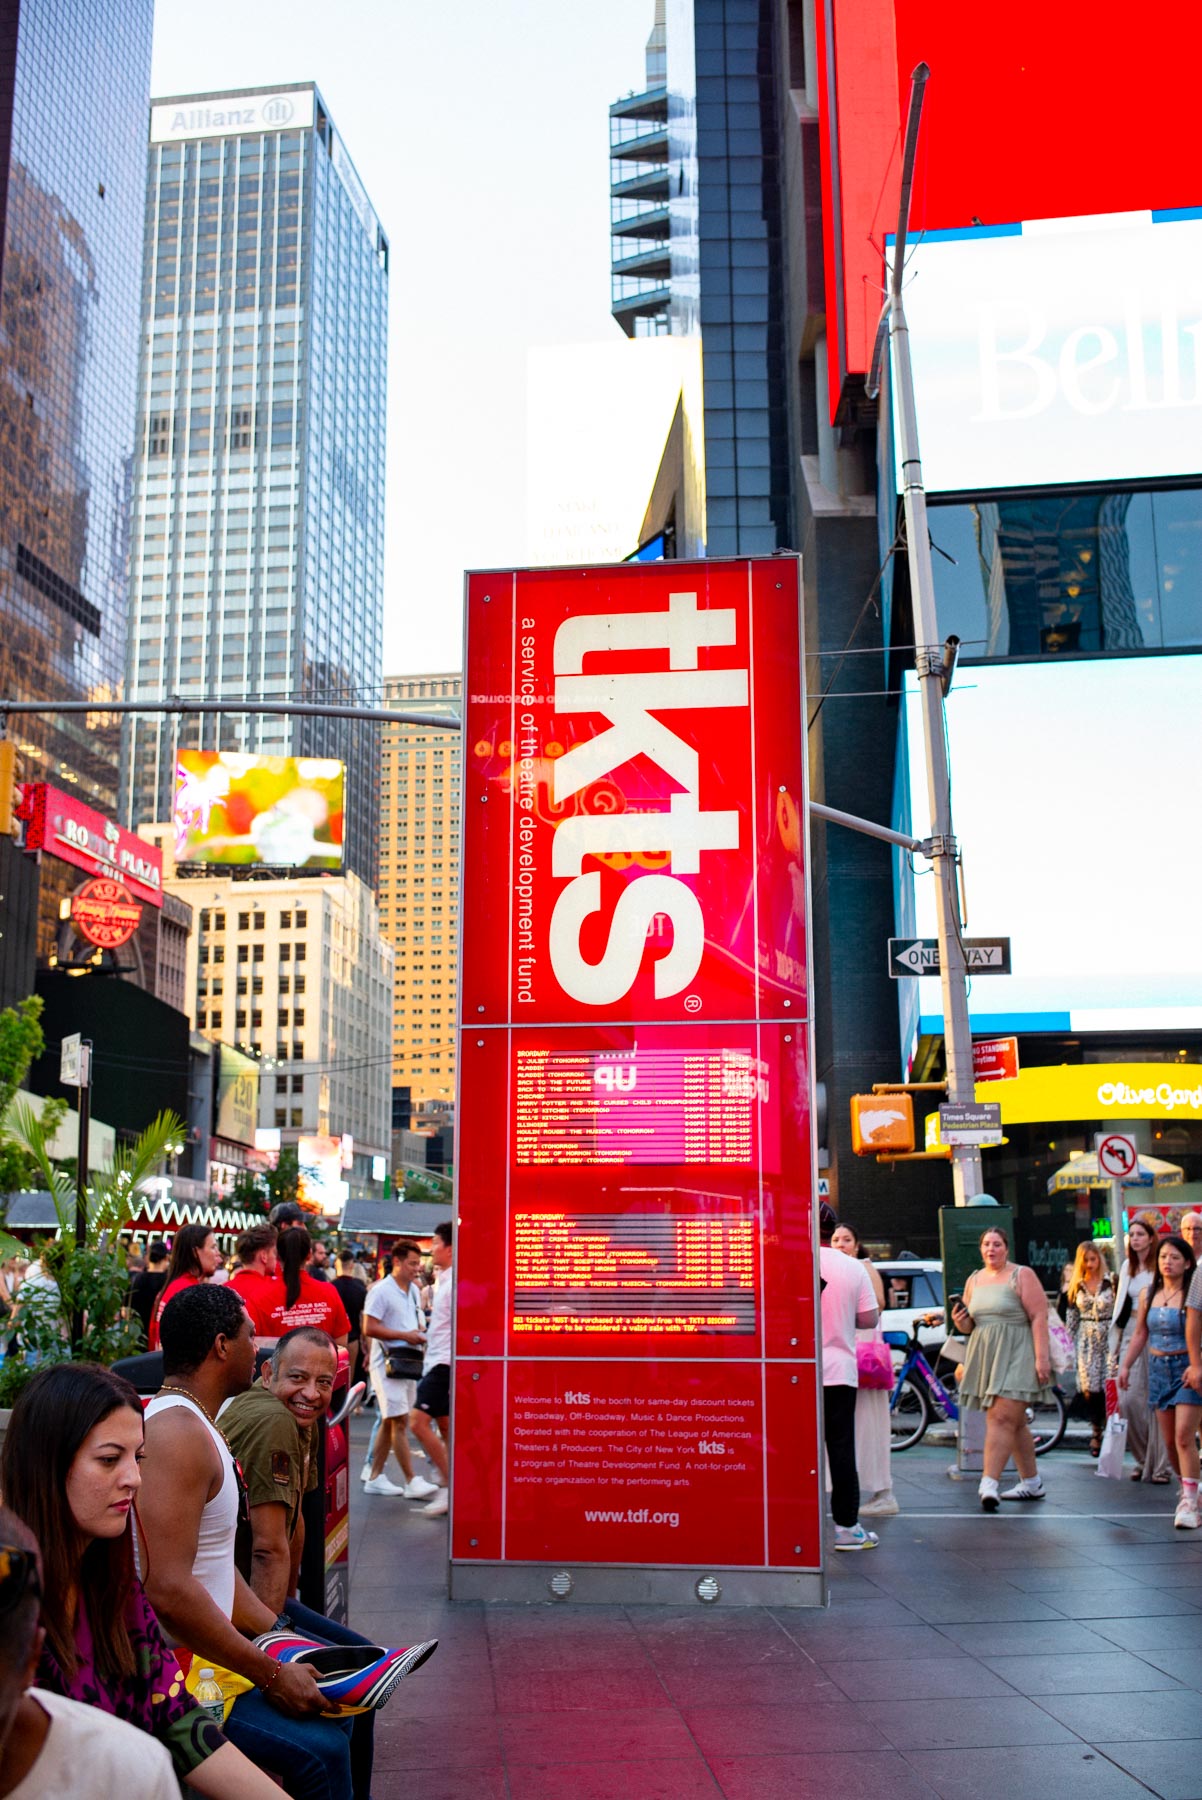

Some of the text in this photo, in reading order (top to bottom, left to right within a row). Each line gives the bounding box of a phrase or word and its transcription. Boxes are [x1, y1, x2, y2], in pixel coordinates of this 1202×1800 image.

[171, 108, 256, 131] Allianz
[548, 592, 749, 1006] tkts
[514, 618, 538, 1003] a service of theatre development fund
[121, 849, 160, 885] PLAZA
[93, 883, 124, 899] HOT
[90, 924, 124, 940] NOW
[908, 950, 940, 965] ONE
[981, 1043, 1010, 1054] STANDING
[1098, 1082, 1156, 1106] Olive
[965, 1113, 992, 1121] Square
[564, 1391, 591, 1405] tkts
[648, 1398, 688, 1407] same-day
[514, 1428, 552, 1436] Operated
[588, 1430, 636, 1438] cooperation
[668, 1431, 699, 1439] League
[626, 1445, 642, 1454] City
[698, 1441, 726, 1454] tkts
[521, 1461, 555, 1469] program
[602, 1462, 657, 1470] Development
[694, 1463, 746, 1471] not-for-profit
[545, 1477, 596, 1485] organization
[627, 1478, 672, 1486] performing
[585, 1509, 680, 1527] www.tdf.org
